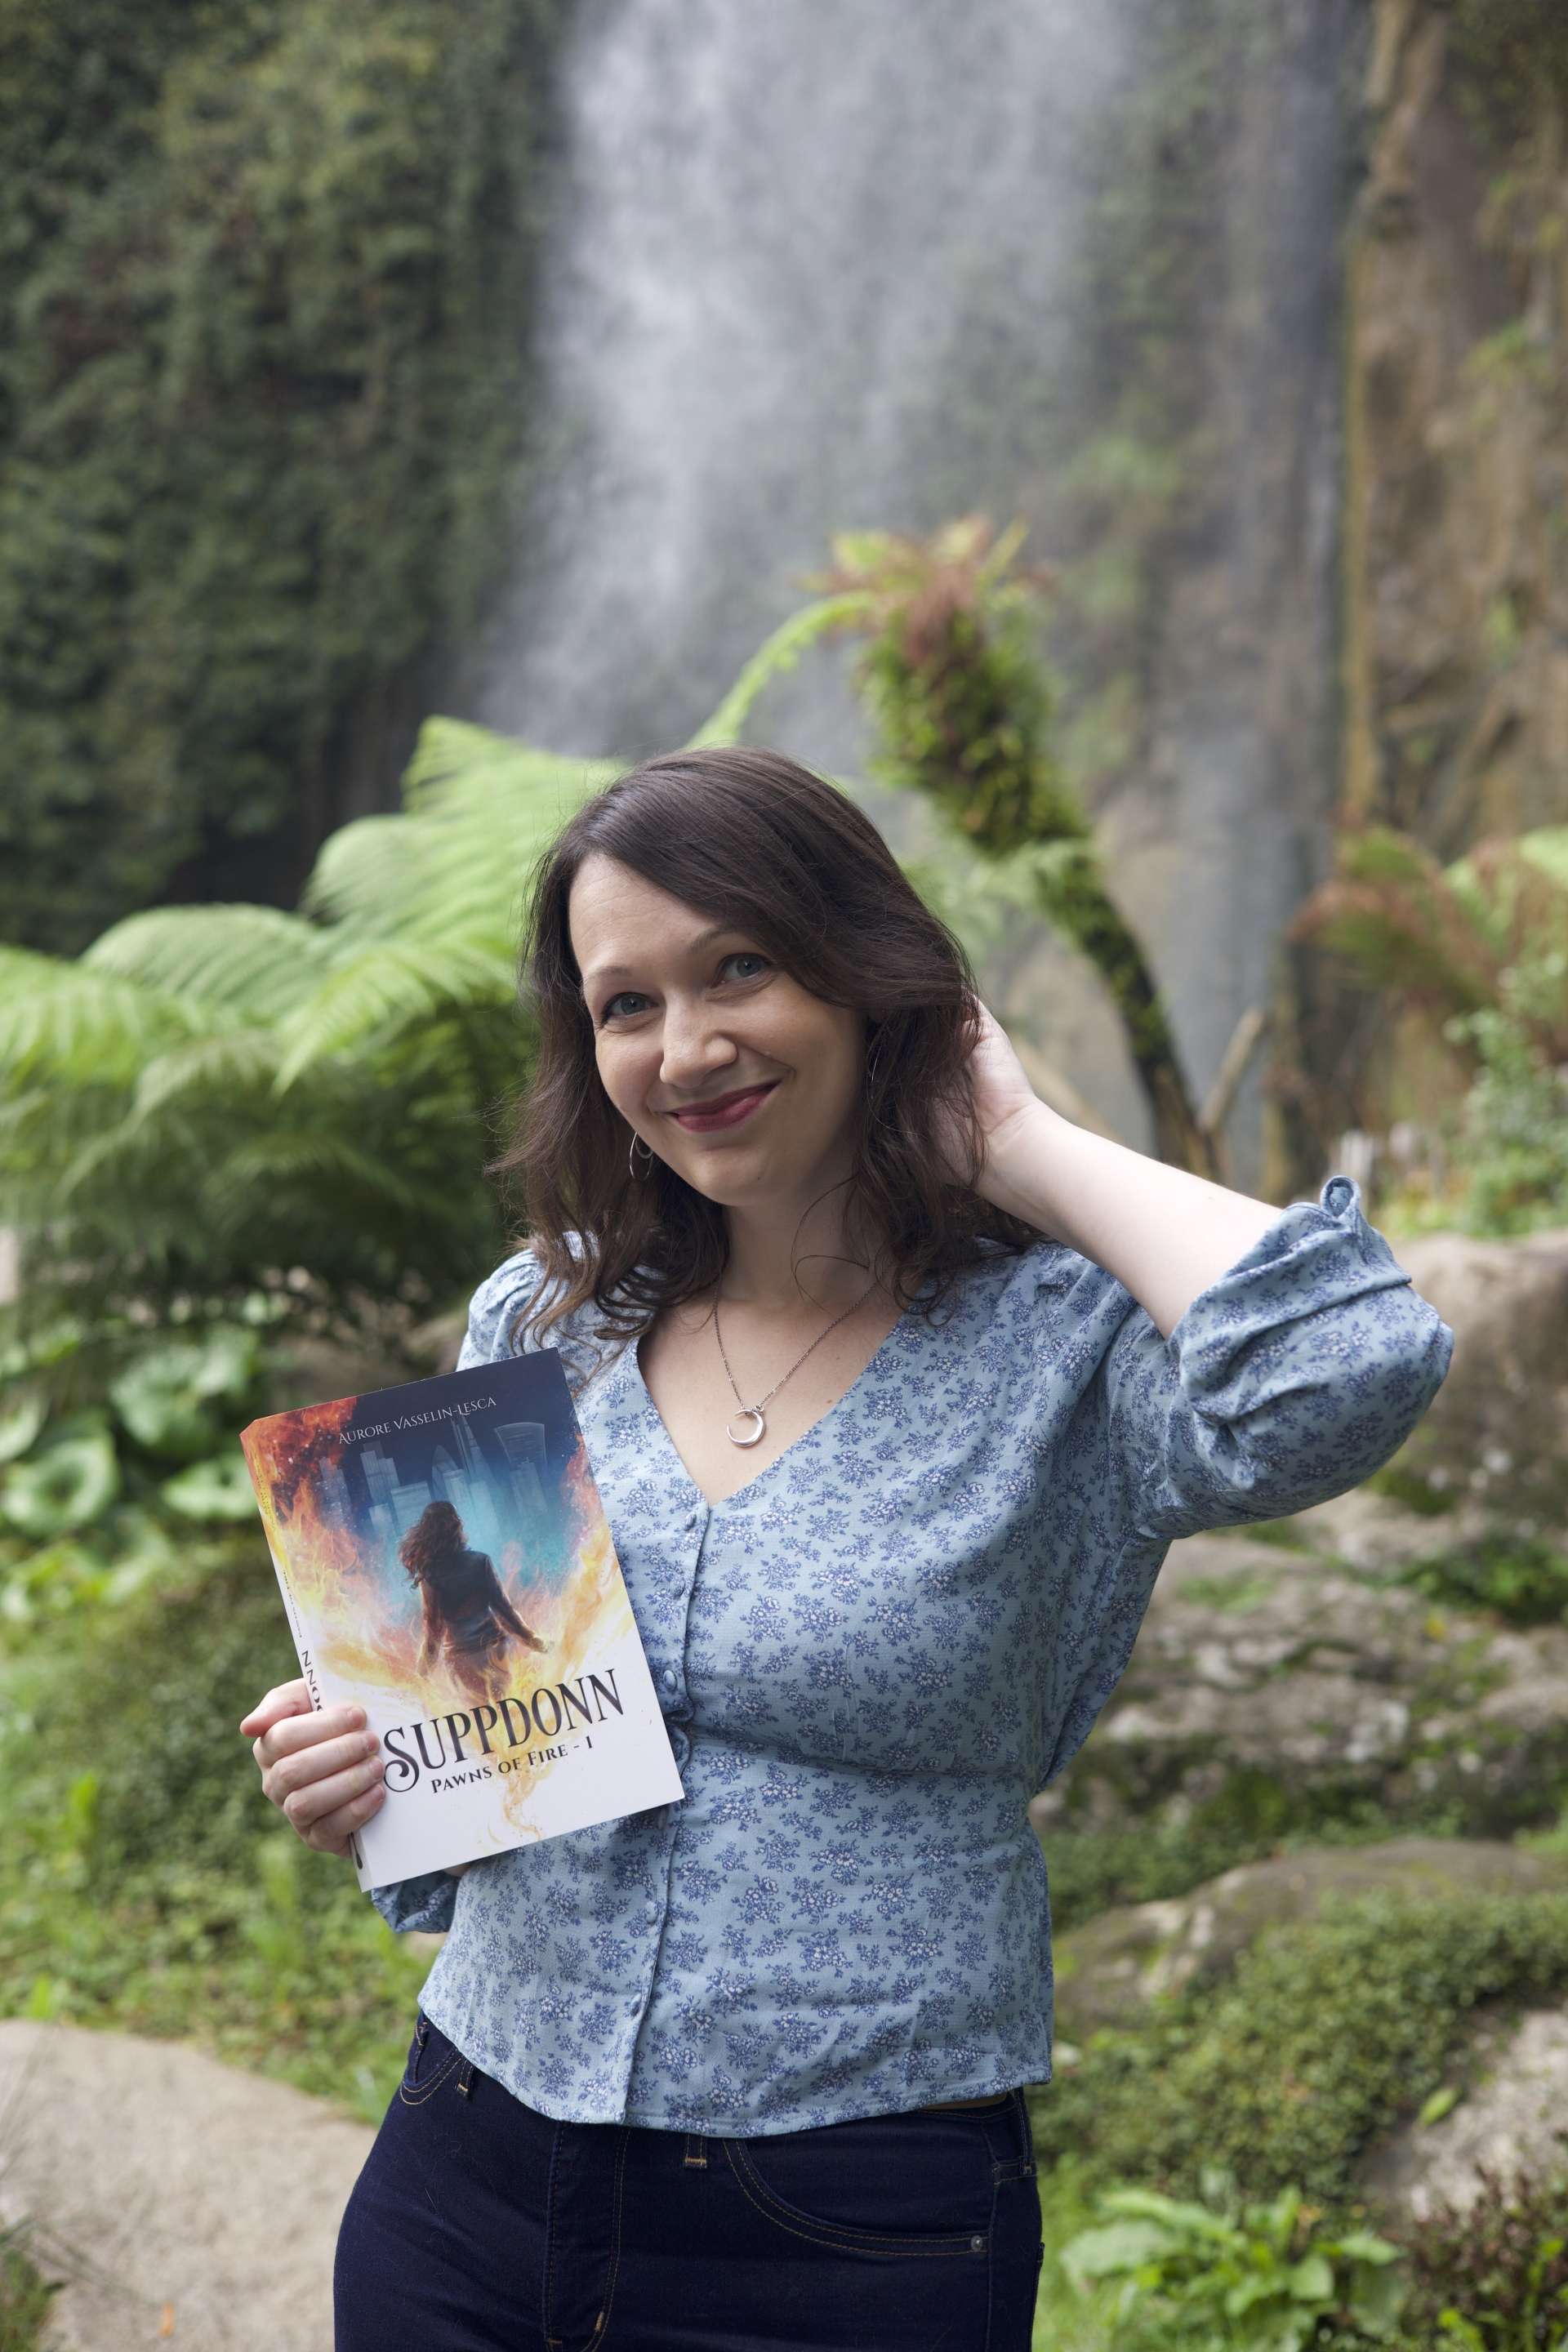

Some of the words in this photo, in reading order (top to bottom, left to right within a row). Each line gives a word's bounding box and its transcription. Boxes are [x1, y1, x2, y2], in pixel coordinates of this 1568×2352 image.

[339, 1422, 391, 1445] AURORE
[394, 1396, 497, 1431] VASSELIN-LESCA
[383, 1668, 624, 1793] SUPPDONN
[431, 1766, 492, 1793] PAWNS
[498, 1757, 521, 1774] OF
[528, 1744, 568, 1766] FIRE
